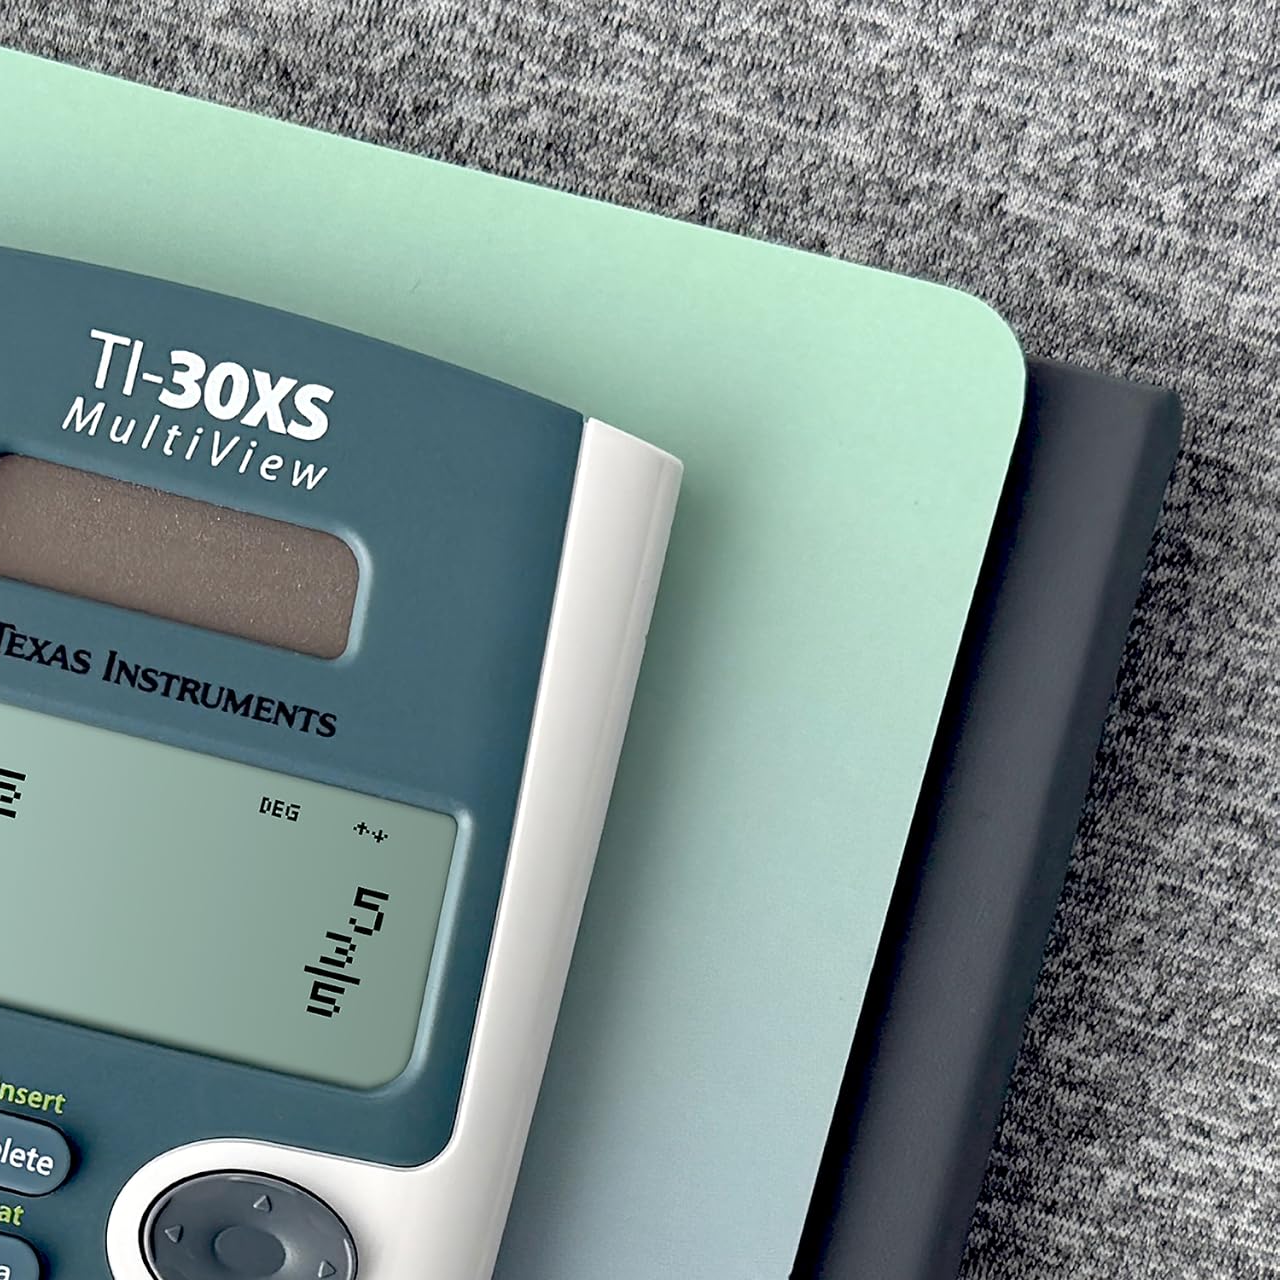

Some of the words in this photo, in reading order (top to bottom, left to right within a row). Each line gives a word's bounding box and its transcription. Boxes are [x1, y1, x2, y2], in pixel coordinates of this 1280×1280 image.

[90, 329, 335, 441] TI-30XS
[62, 397, 328, 490] MultiView
[259, 796, 301, 822] DEG
[349, 886, 389, 936] 5
